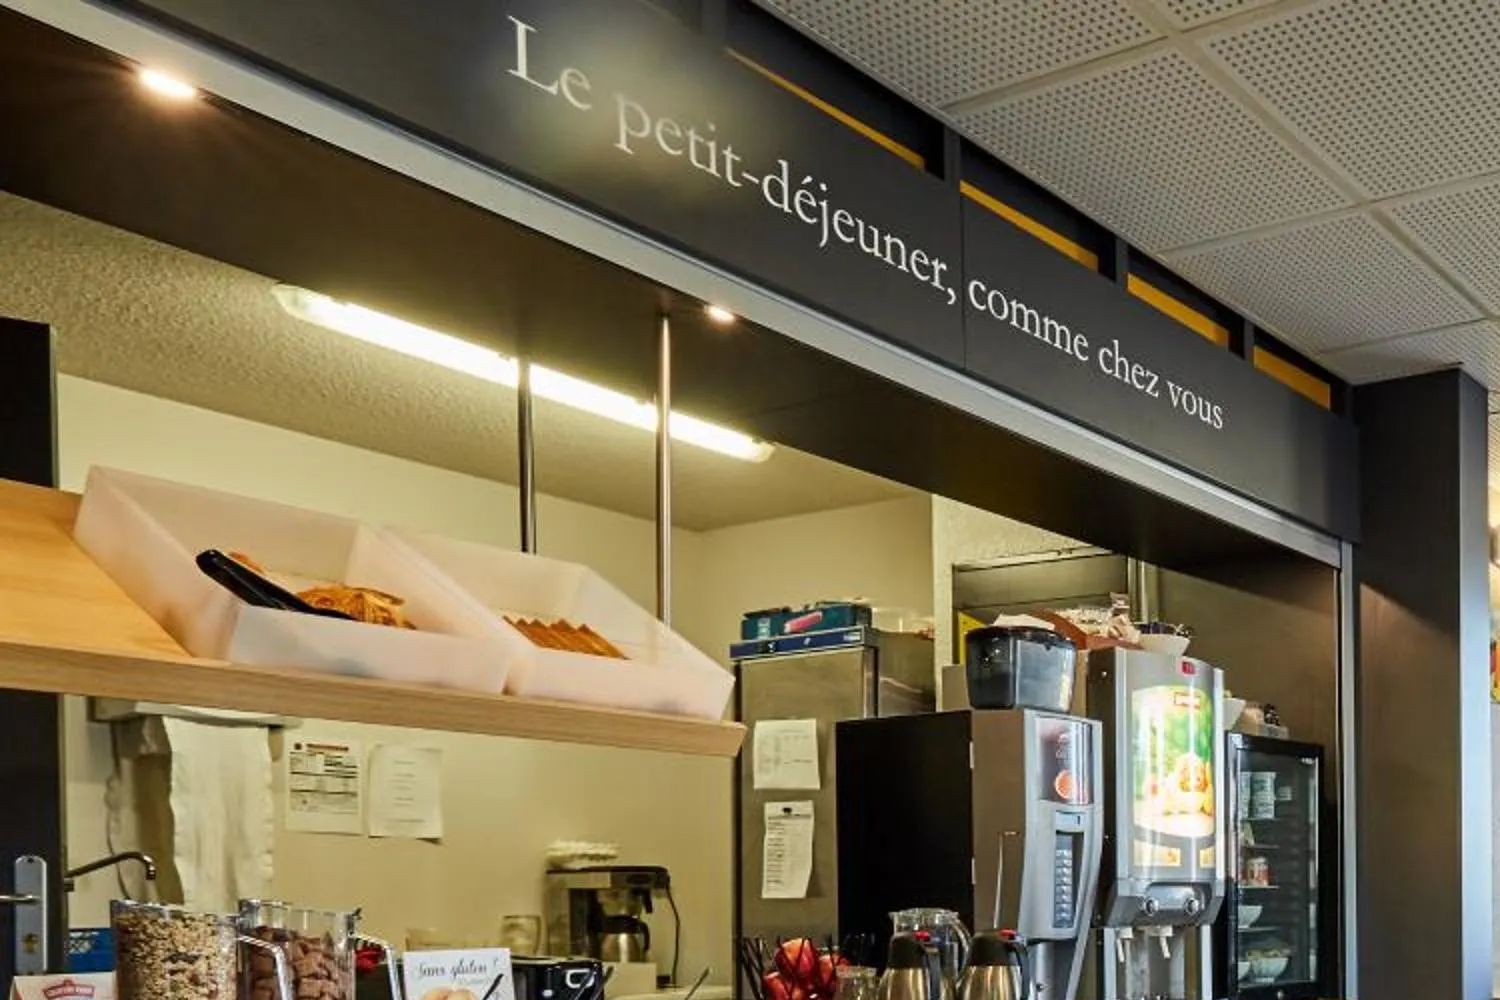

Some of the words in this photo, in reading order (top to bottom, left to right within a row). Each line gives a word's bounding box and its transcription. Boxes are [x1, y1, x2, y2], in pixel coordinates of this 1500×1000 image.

[507, 15, 592, 113] Le
[613, 89, 958, 307] petit-déjeuner,
[968, 278, 1089, 363] comme
[1098, 338, 1161, 398] chez
[1168, 380, 1225, 431] vous
